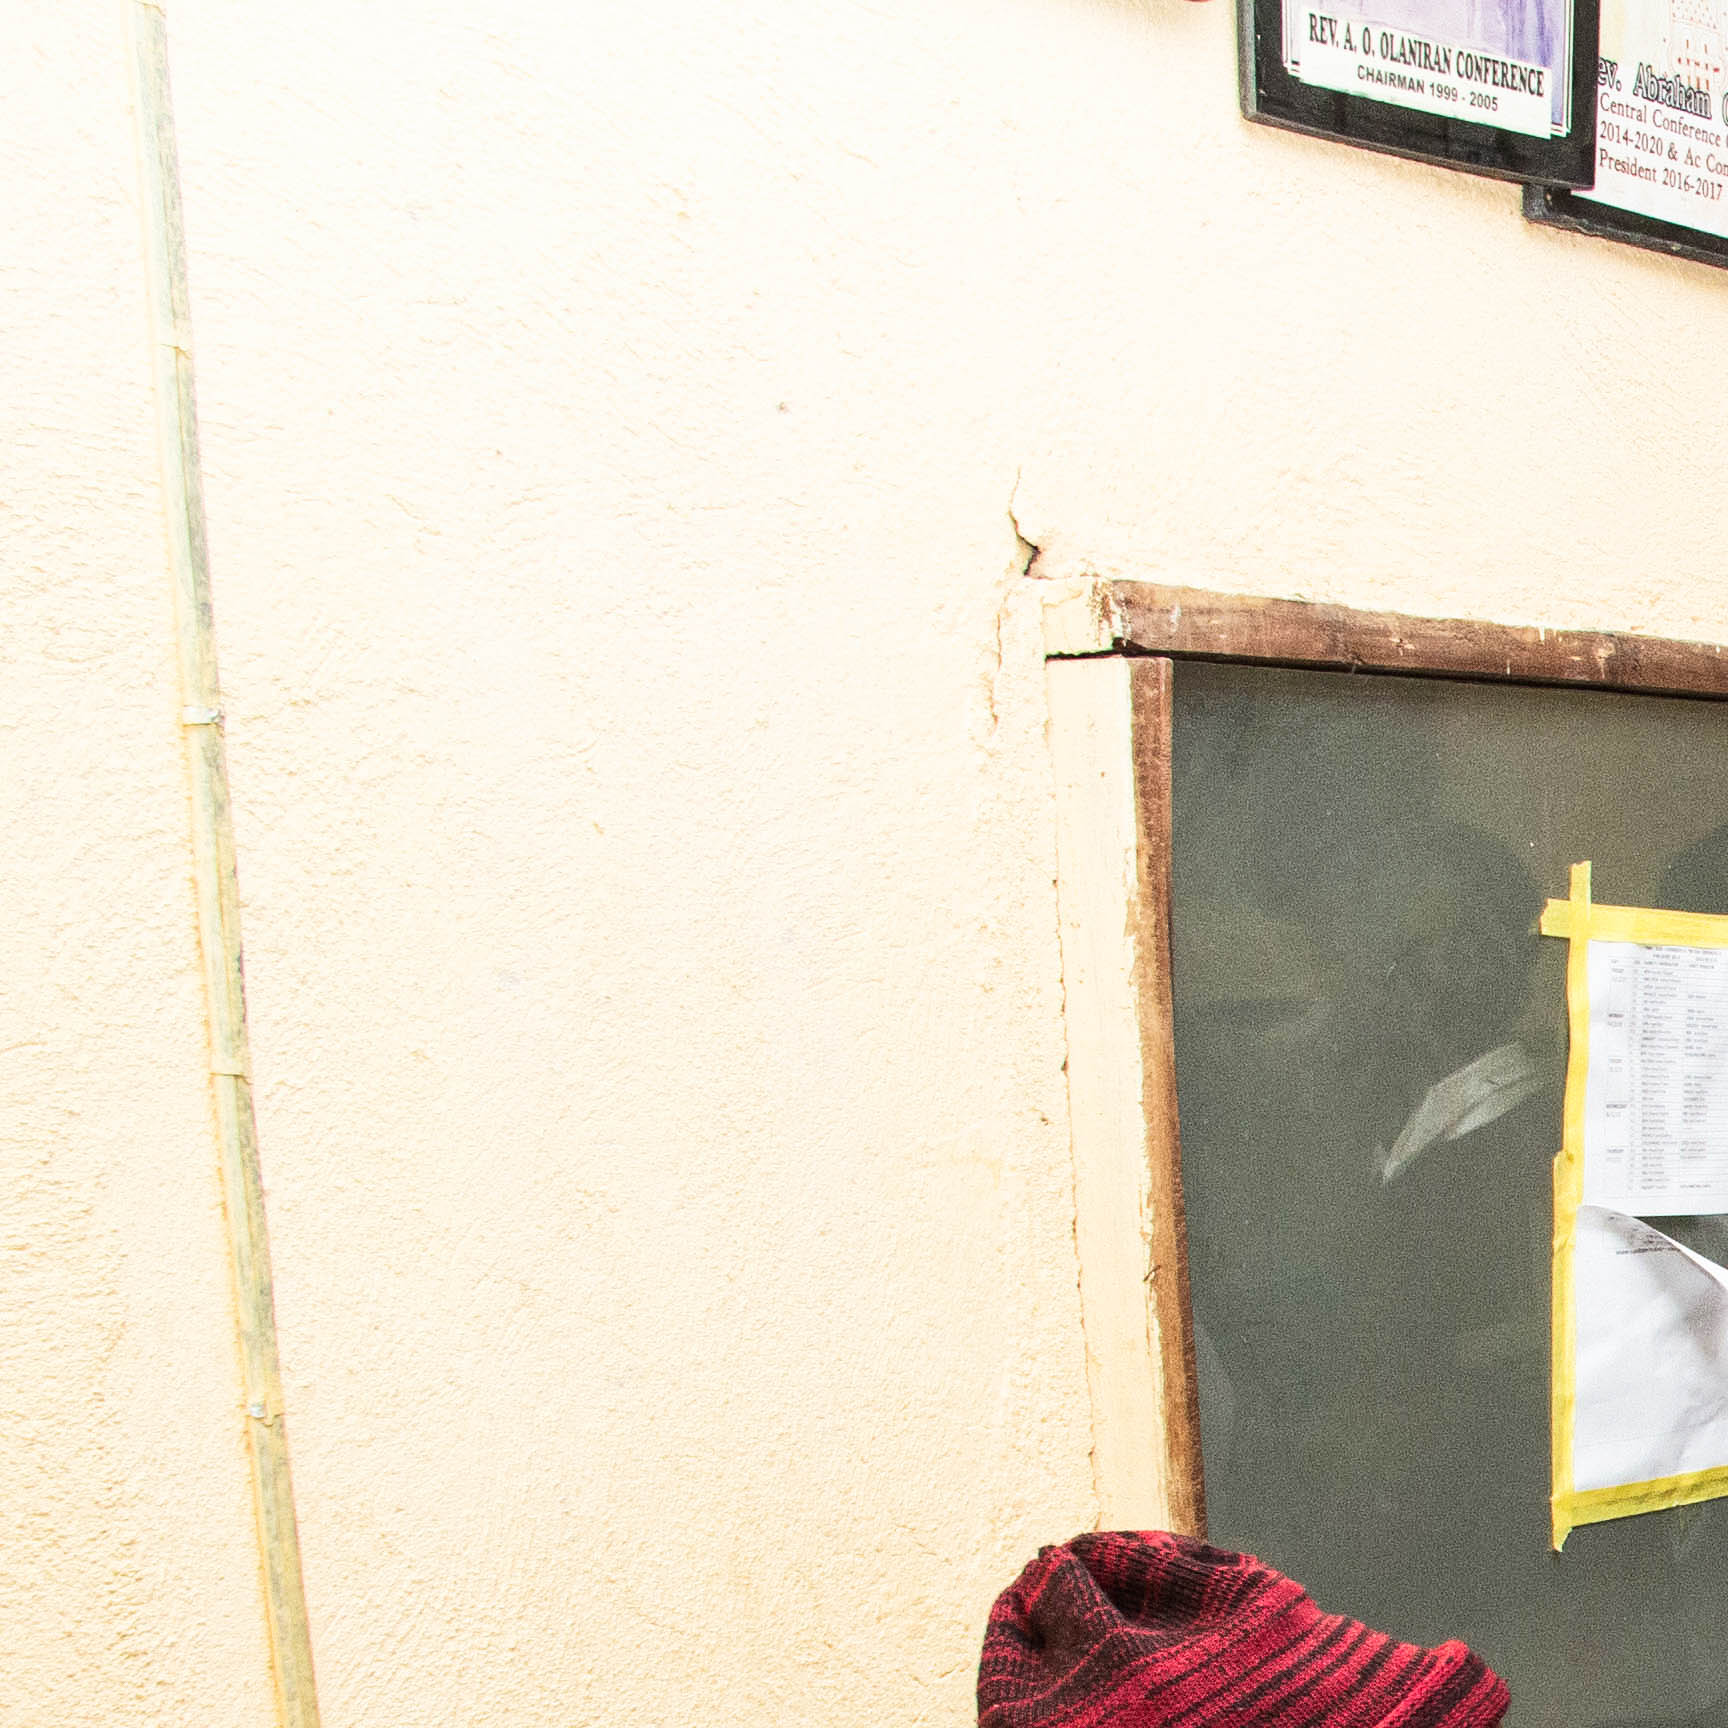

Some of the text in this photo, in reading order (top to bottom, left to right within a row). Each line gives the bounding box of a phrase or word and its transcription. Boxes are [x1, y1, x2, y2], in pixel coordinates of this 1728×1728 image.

[1308, 12, 1545, 98] REV. A. O. OLANIRAN CONFERENCE
[1356, 64, 1425, 95] CHAIRMAN
[1429, 83, 1458, 102] 1999
[1470, 91, 1499, 112] 2005
[1597, 57, 1623, 92] ev.
[1632, 61, 1713, 120] Abraham
[1599, 120, 1664, 157] 2014-2020
[1667, 142, 1679, 161] &
[1684, 148, 1701, 169] Ac
[1600, 92, 1648, 124] Central
[1652, 109, 1721, 148] Conference
[1599, 148, 1724, 201] President 2016-2017
